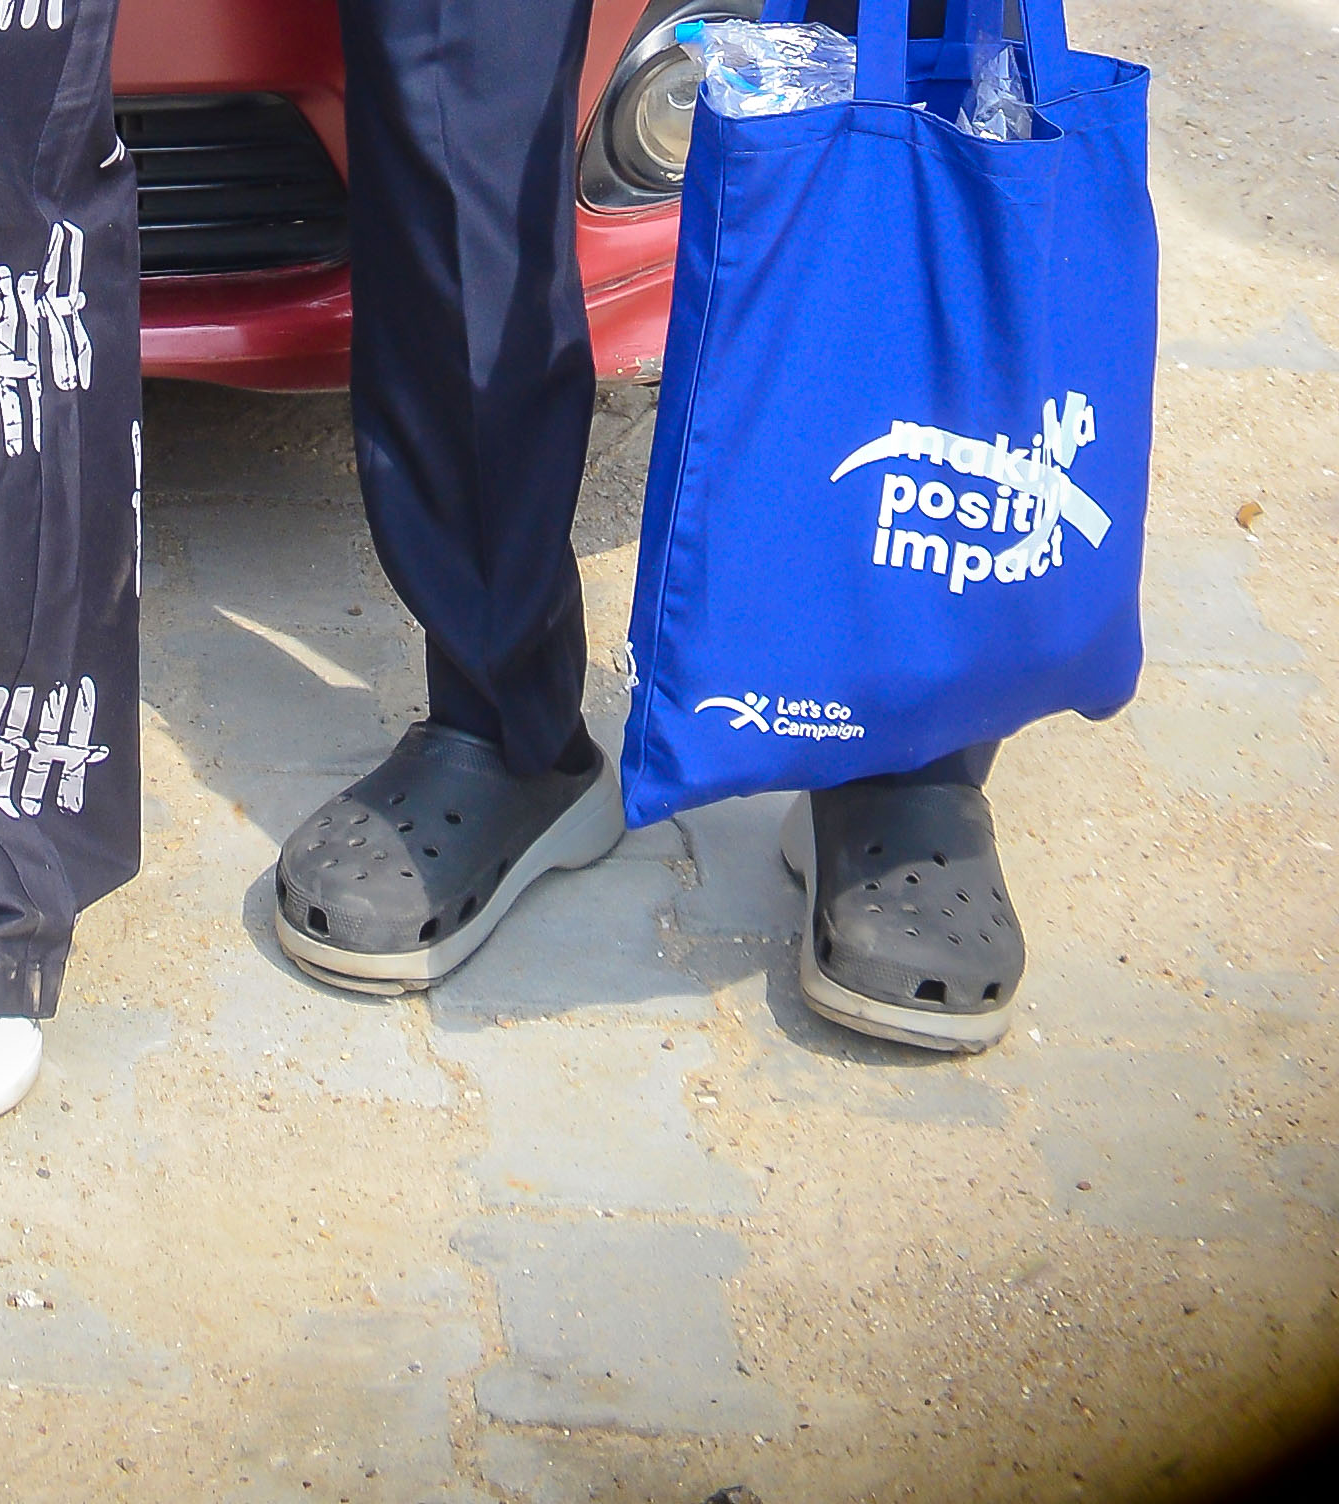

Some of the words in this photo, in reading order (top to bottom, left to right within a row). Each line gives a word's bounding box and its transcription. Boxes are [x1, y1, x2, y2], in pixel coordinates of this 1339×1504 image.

[776, 696, 822, 718] Let's
[823, 700, 851, 721] Go
[773, 718, 865, 741] Campaign
